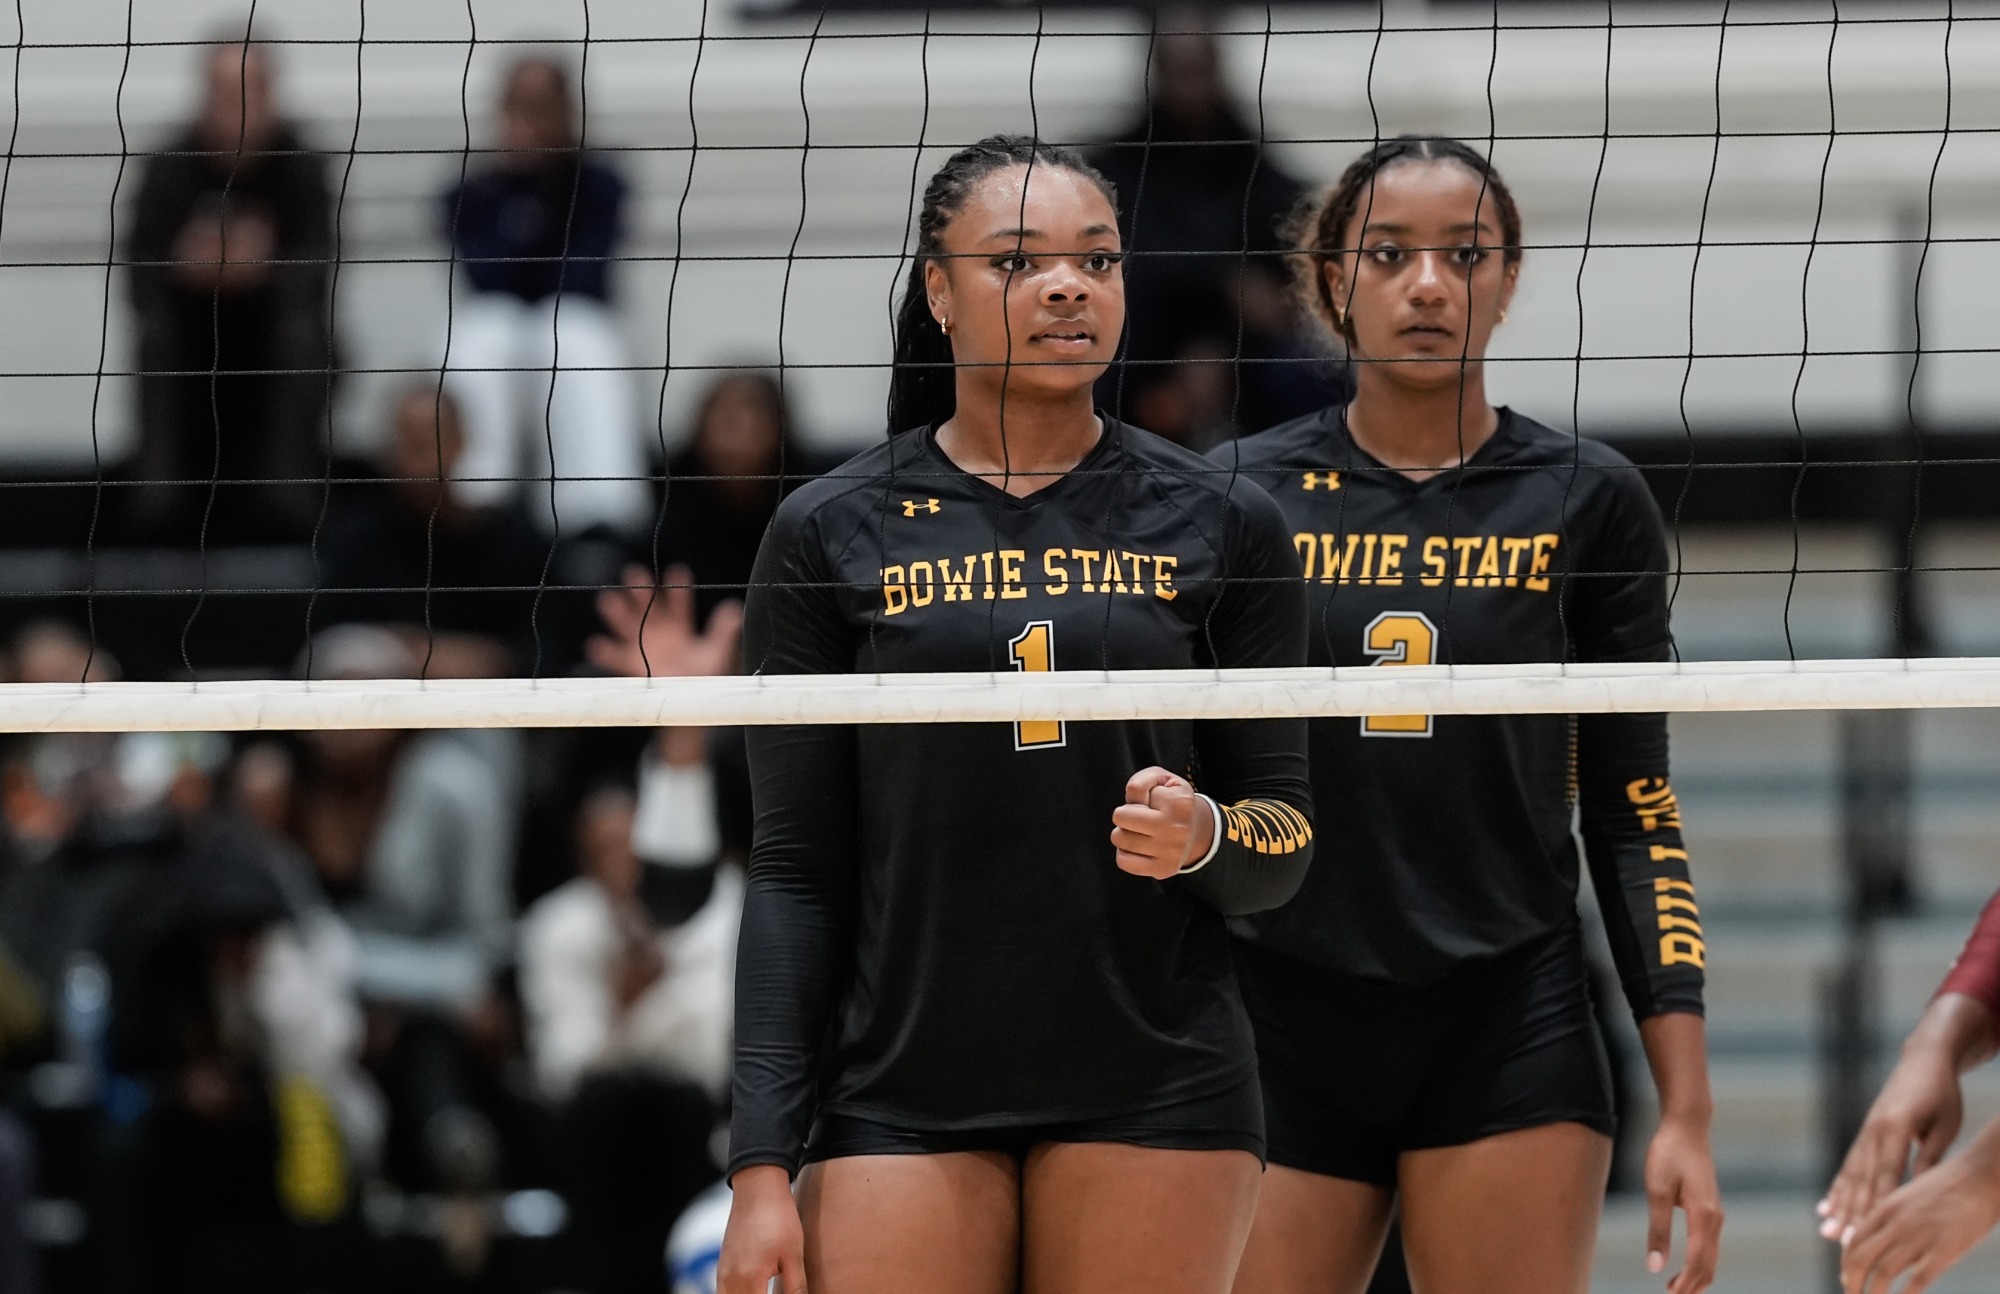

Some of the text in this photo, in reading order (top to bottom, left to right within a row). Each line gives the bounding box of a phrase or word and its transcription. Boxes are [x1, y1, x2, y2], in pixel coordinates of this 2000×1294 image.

[880, 548, 1178, 616] BOWIE STATE
[1292, 532, 1560, 592] OWIE STATE
[1008, 619, 1067, 751] 1
[1360, 610, 1439, 738] 2
